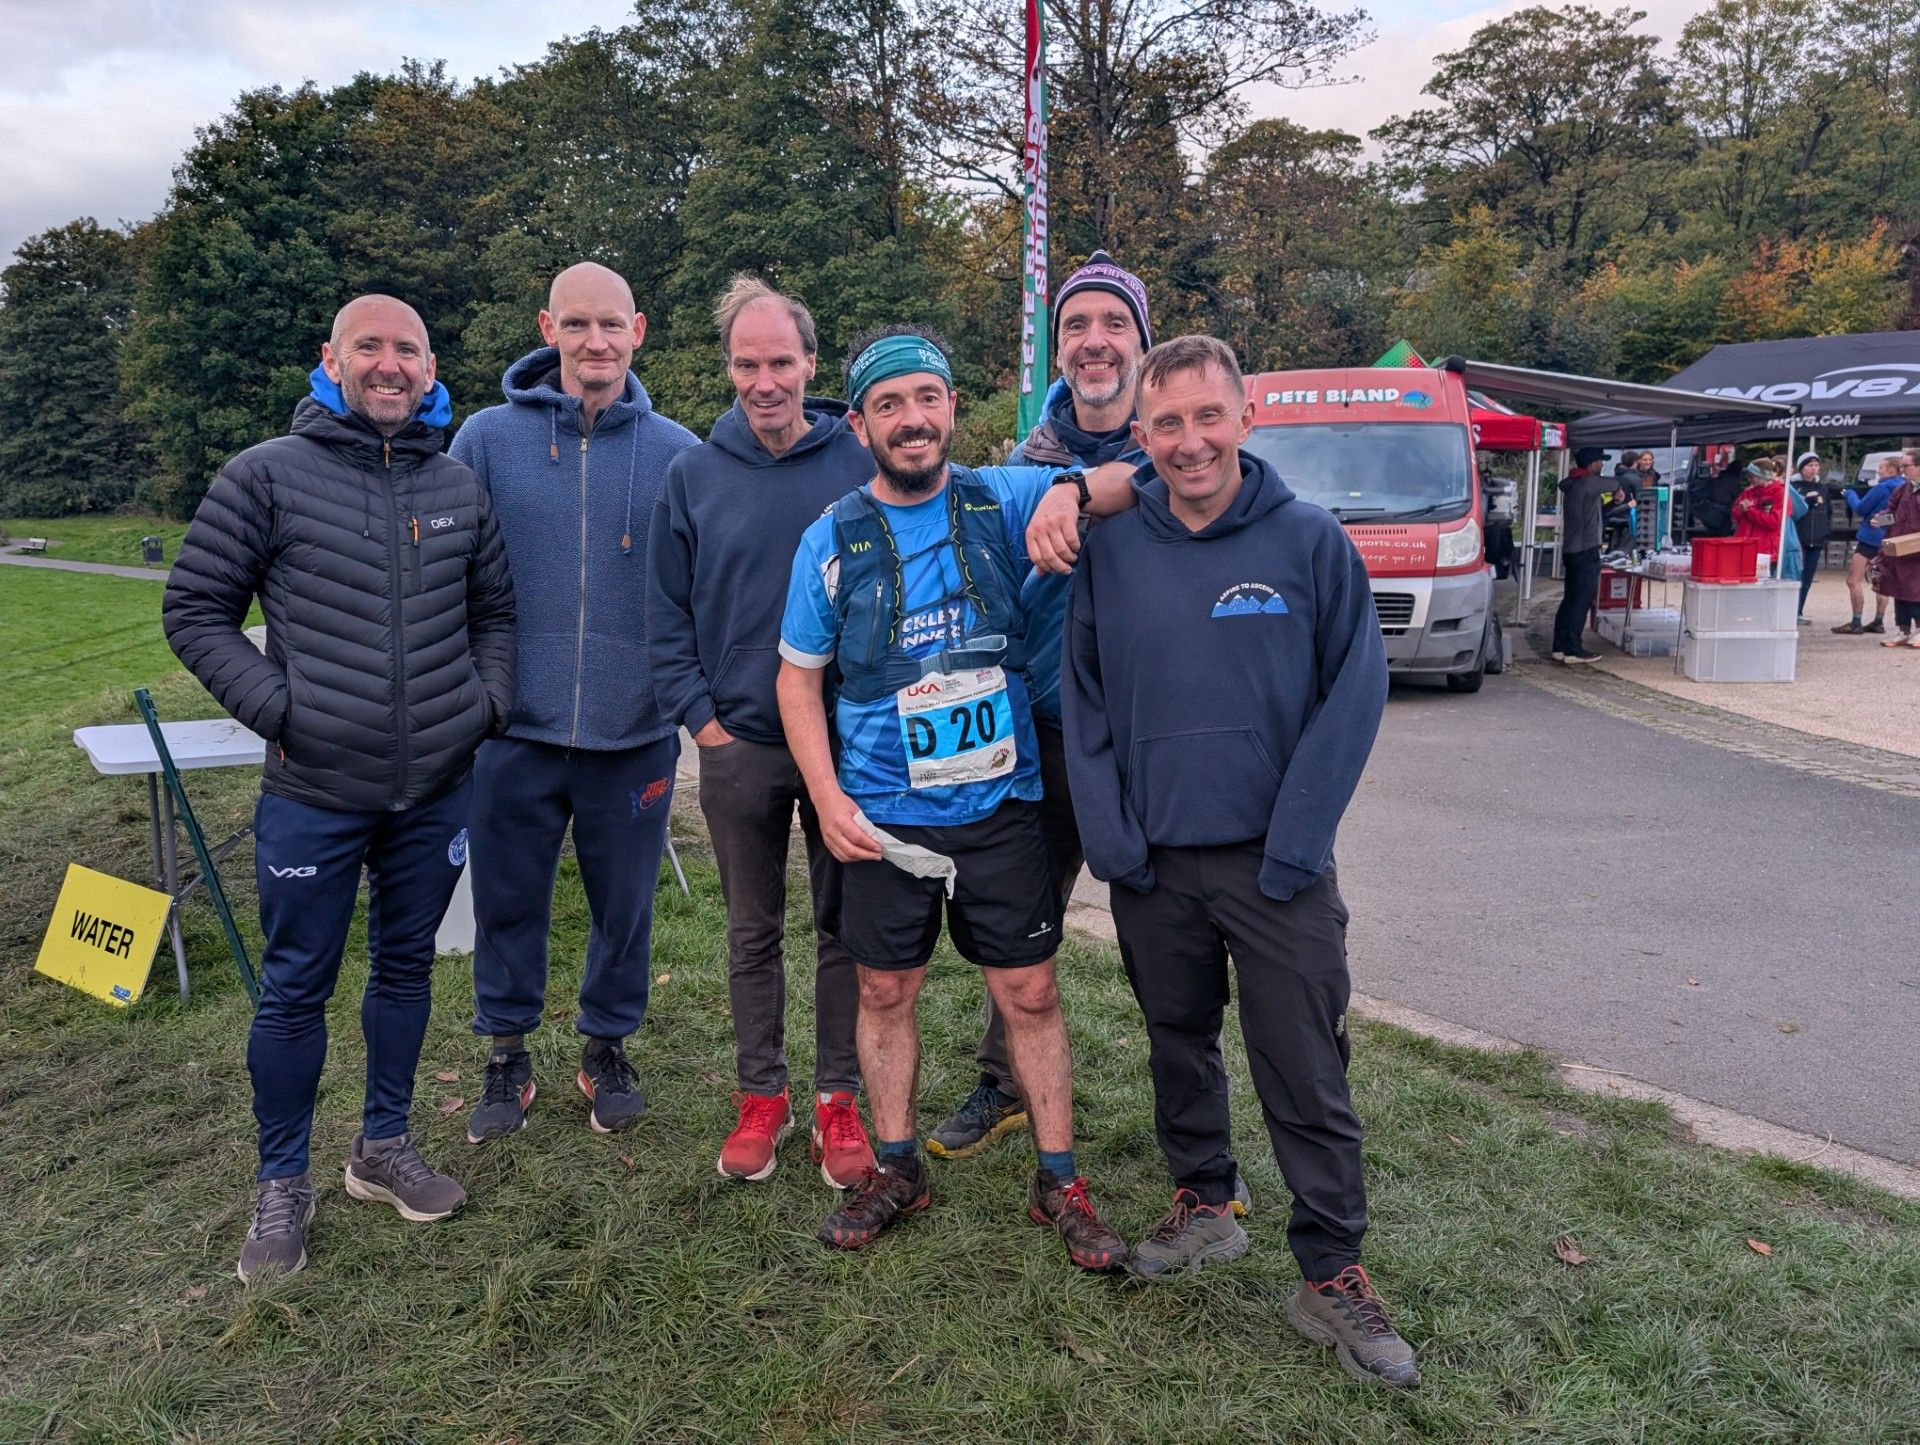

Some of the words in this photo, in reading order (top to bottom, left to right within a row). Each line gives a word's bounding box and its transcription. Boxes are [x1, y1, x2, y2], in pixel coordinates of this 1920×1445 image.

[1024, 112, 1042, 277] BLAND
[1034, 122, 1048, 297] SPORTS
[1022, 292, 1034, 395] PETE
[1264, 390, 1319, 405] PETE
[1325, 388, 1400, 403] BLAND
[430, 516, 456, 529] OEX
[850, 541, 872, 553] VIA
[1219, 584, 1241, 602] ASPIRE
[1250, 583, 1275, 595] ASCEND
[907, 683, 941, 697] UKA
[905, 716, 937, 759] D
[950, 700, 996, 752] 20
[267, 865, 318, 879] VX3
[70, 909, 135, 960] WATER
